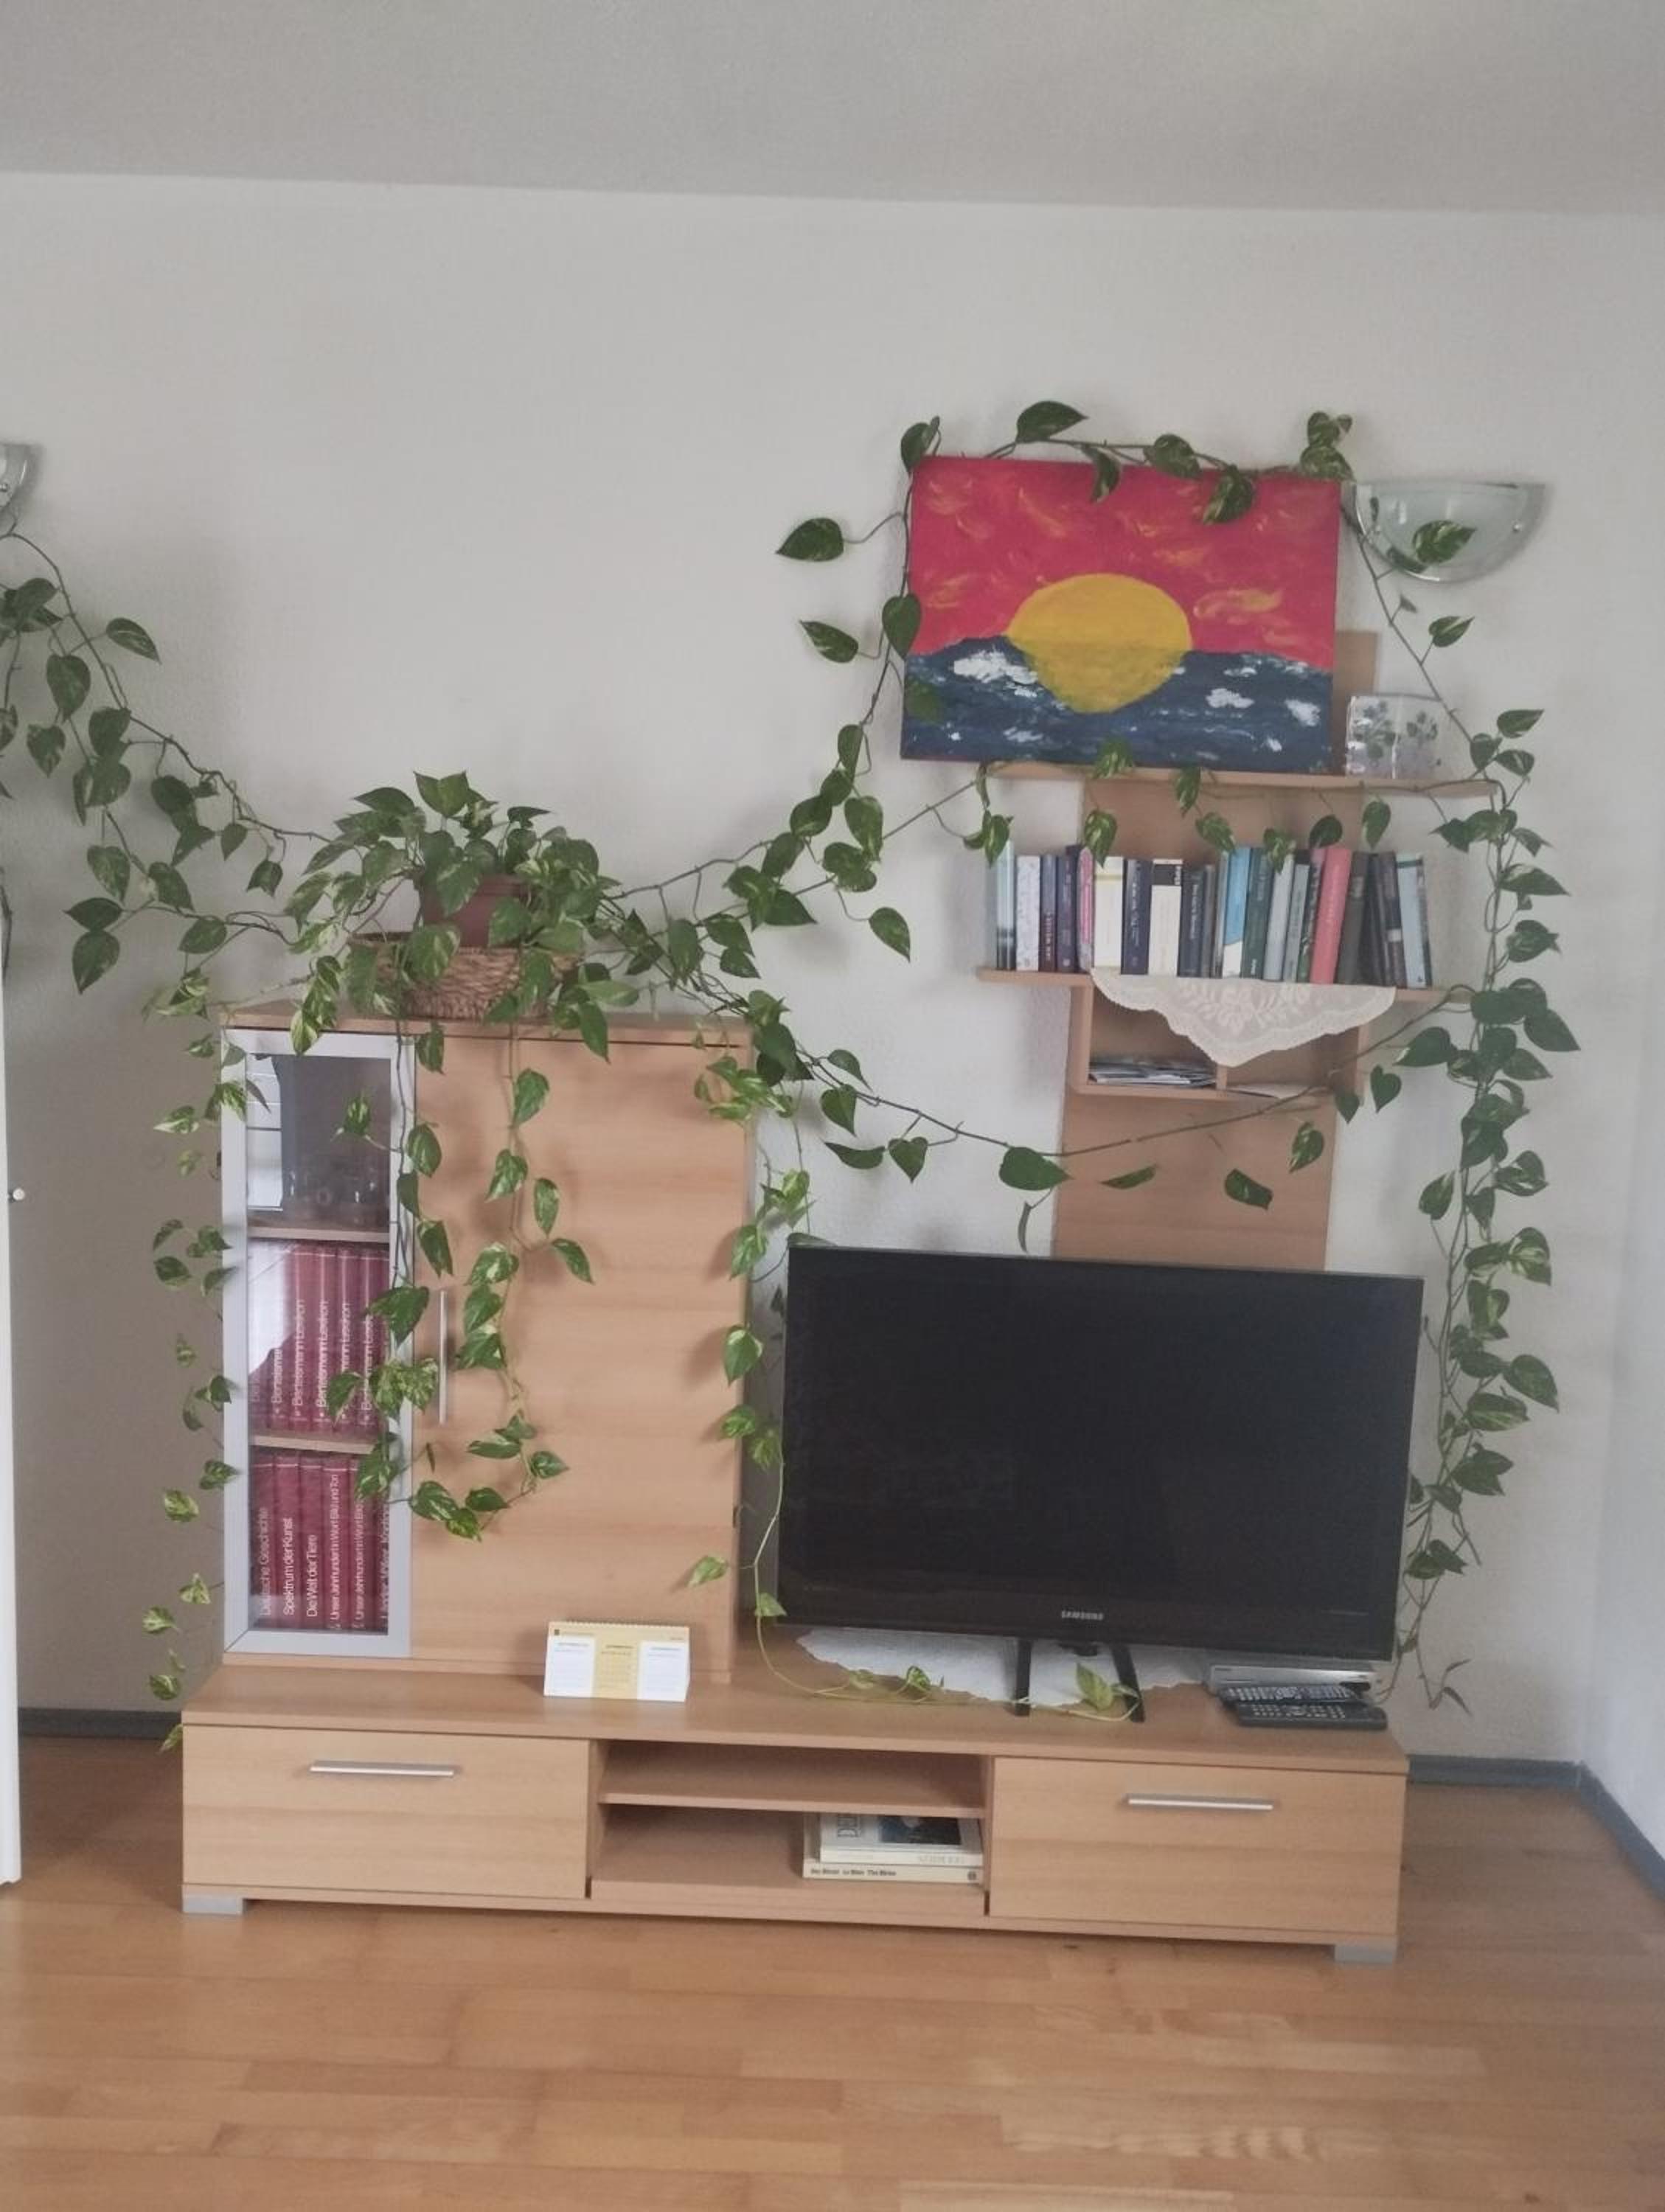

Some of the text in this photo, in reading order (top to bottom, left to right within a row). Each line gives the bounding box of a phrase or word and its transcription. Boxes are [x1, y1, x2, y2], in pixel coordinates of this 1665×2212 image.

[281, 1517, 295, 1616] Spektrum der Kunst
[306, 1534, 318, 1617] Die Welt der Tiere
[330, 1548, 340, 1596] Jahrhundert
[330, 1596, 340, 1620] Unser
[354, 1596, 364, 1620] Unser
